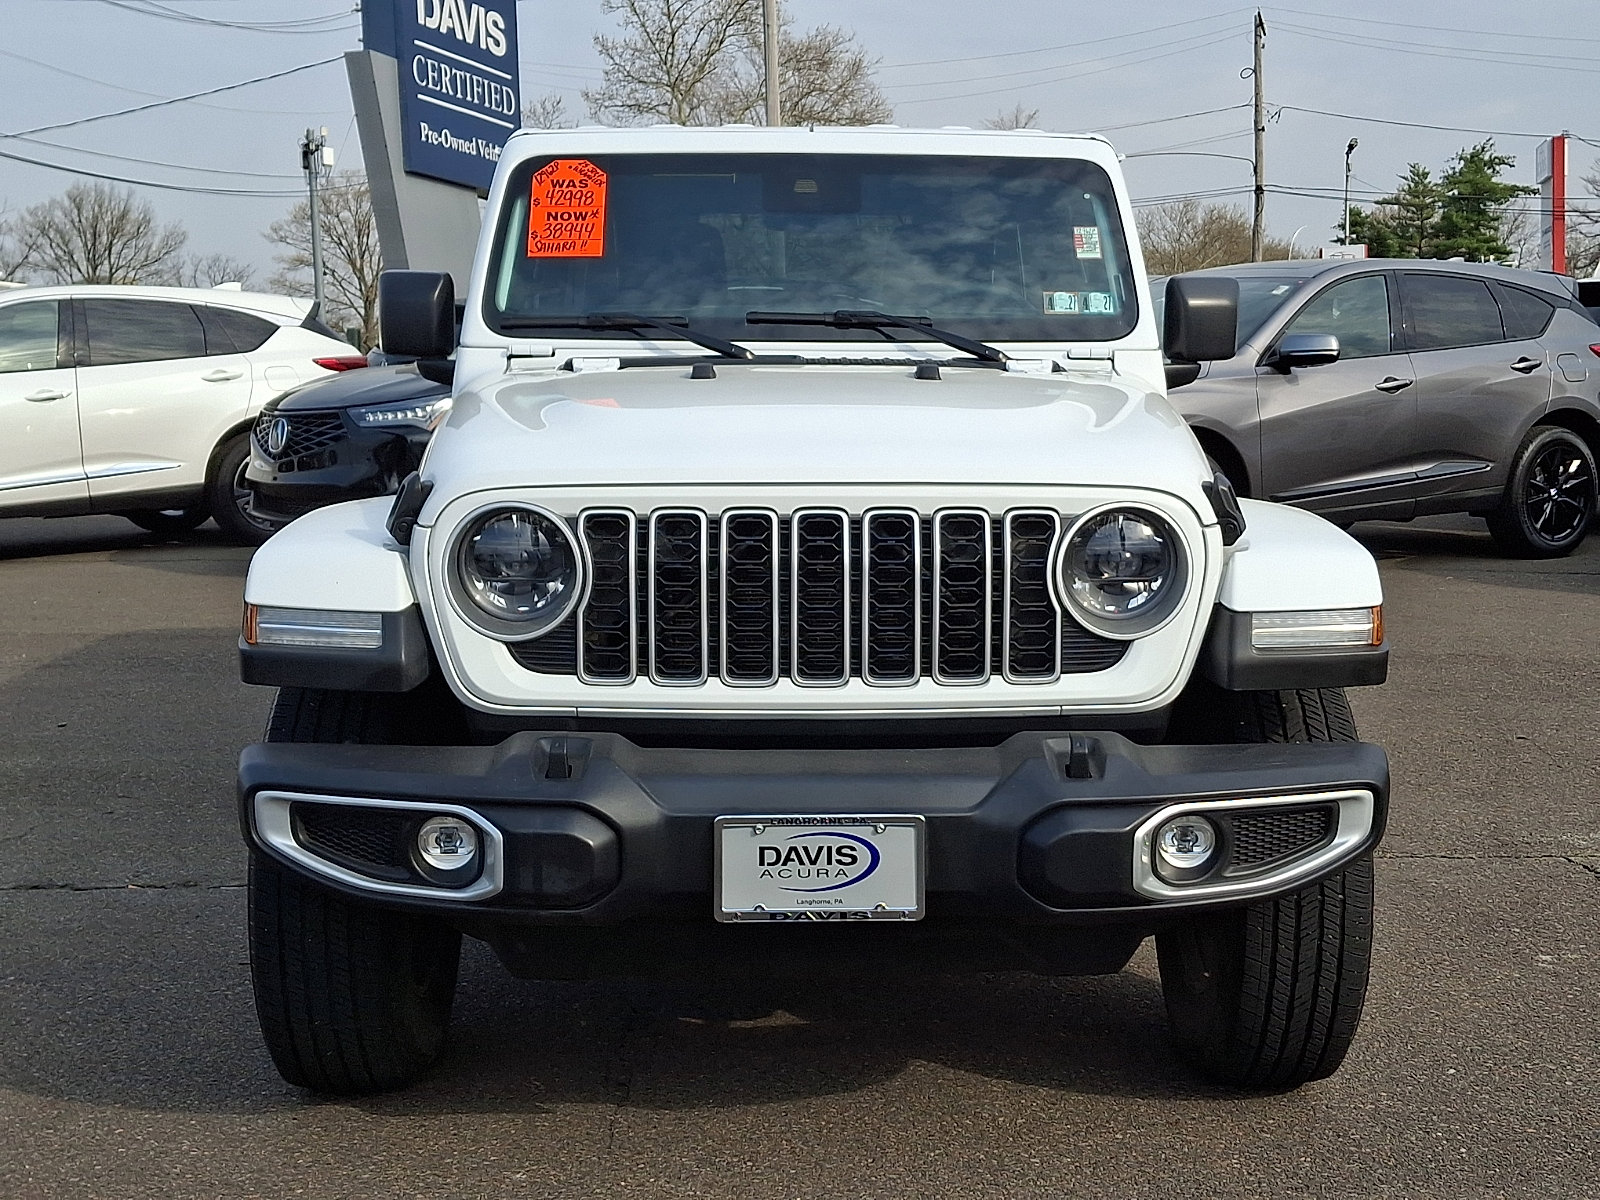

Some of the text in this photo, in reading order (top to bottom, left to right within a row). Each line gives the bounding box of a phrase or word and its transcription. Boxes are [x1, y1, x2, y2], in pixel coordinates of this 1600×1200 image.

[416, 0, 506, 57] DAVIS
[412, 54, 516, 116] CERTIFIED
[420, 121, 477, 156] Pre-Owned
[551, 179, 589, 188] WAS
[532, 189, 594, 207] $ 42998
[530, 222, 595, 240] $ 38944
[529, 240, 577, 253] SAHARA
[758, 845, 858, 867] DAVIS
[759, 868, 849, 879] ACURA
[796, 898, 833, 906] Langhorne,
[769, 911, 872, 920] DAVIS
